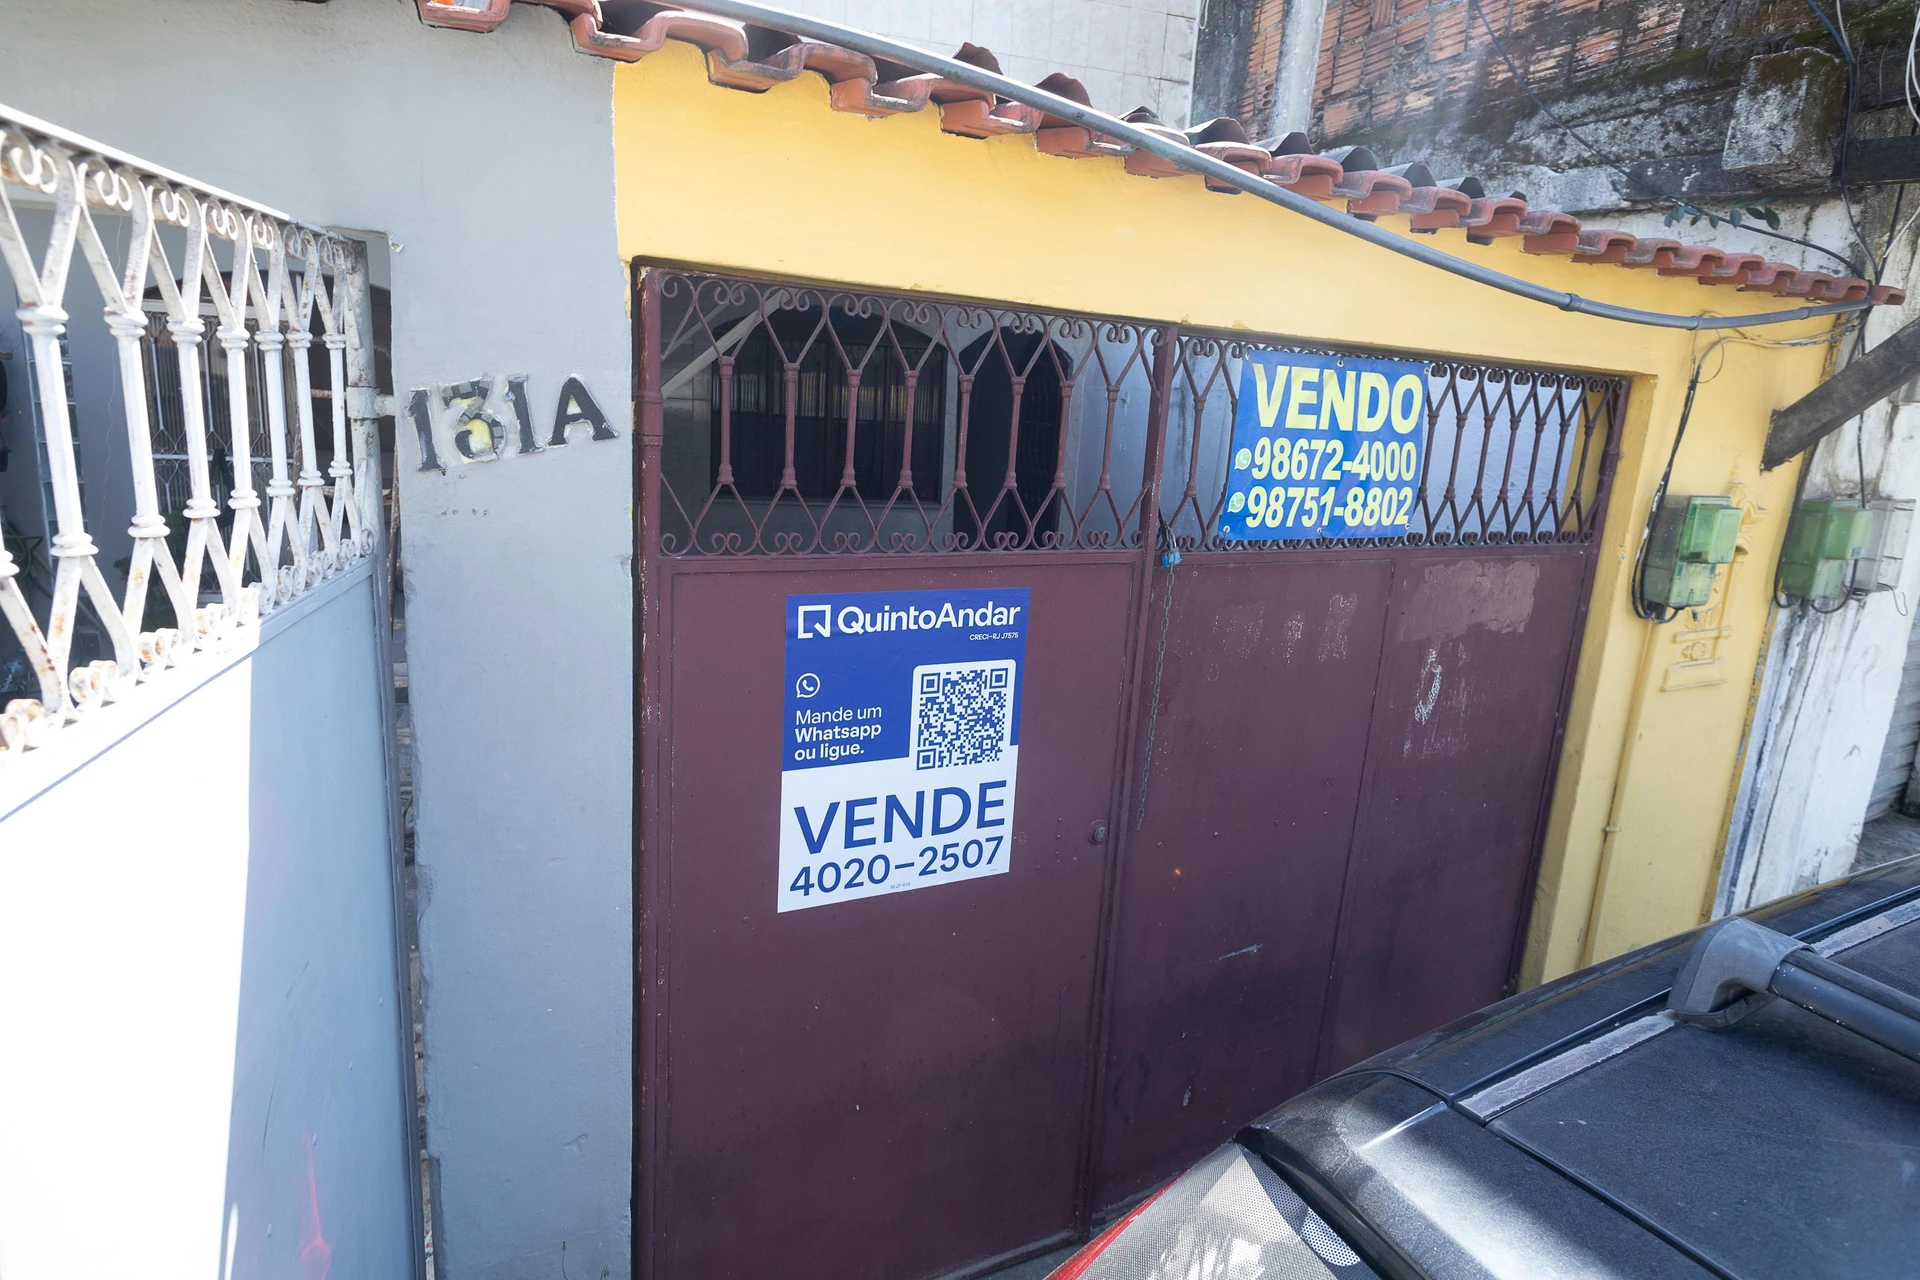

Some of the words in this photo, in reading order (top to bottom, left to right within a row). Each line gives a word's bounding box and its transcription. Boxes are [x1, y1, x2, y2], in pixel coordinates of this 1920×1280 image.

[1252, 362, 1423, 434] VENDO
[1251, 436, 1417, 482] 98672-4000
[1245, 485, 1413, 528] 98751-8802
[837, 600, 1021, 635] QuintoAndar
[969, 632, 1000, 641] CRECI-RJ
[794, 724, 882, 743] Whatsapp
[795, 706, 853, 725] Mande
[857, 706, 882, 720] um
[794, 747, 816, 761] ou
[820, 742, 865, 761] ligue.
[793, 779, 1007, 855] VENDE
[789, 835, 1004, 897] 4020-2507
